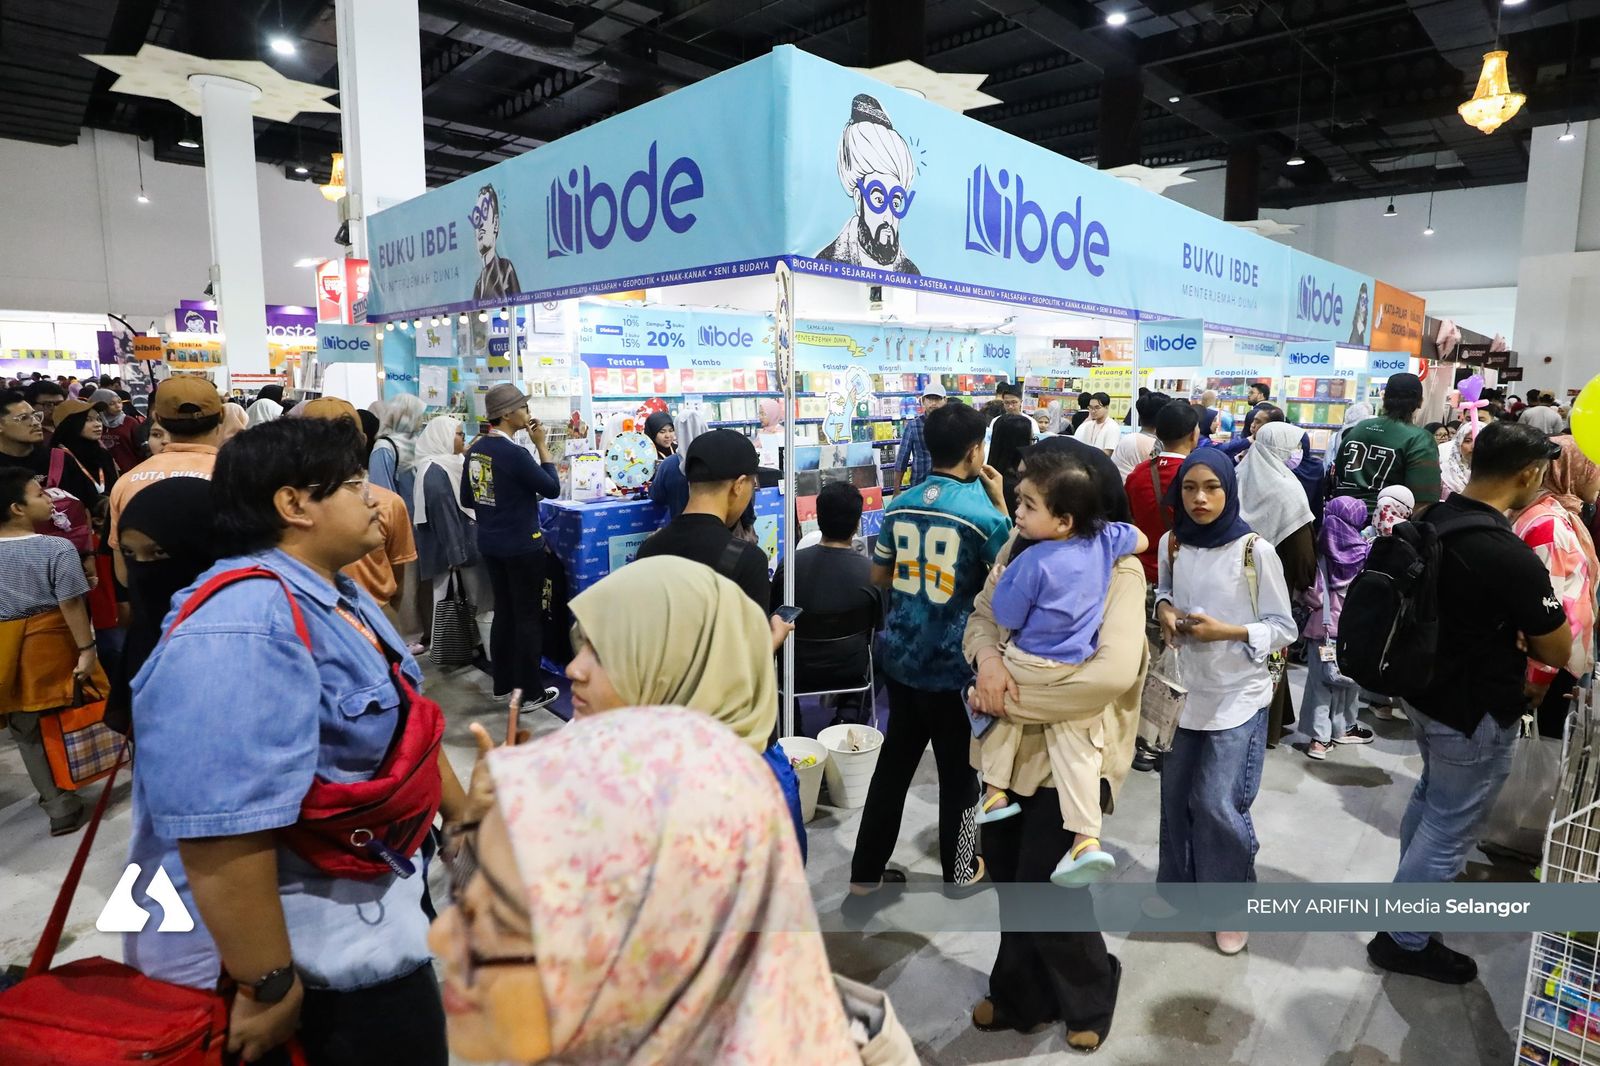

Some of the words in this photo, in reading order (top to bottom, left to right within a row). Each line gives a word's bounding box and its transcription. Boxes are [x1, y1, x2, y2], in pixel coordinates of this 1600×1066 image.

[378, 235, 415, 269] BUKU
[420, 221, 458, 258] IBDE
[1182, 242, 1224, 278] BUKU
[1229, 257, 1259, 288] IBDE
[592, 283, 618, 292] FALSAFAH
[622, 277, 655, 288] GEOPOLITIK
[661, 271, 707, 282] KANAK-KANAK
[714, 265, 730, 276] SENI
[731, 264, 737, 274] &
[739, 261, 770, 273] BUDAYA
[792, 257, 832, 273] BIOGRAFI
[841, 266, 877, 280] SEJARAH
[885, 273, 912, 285] AGAMA
[919, 279, 948, 290] SASTERA
[954, 284, 971, 294] ALAM
[972, 287, 995, 298] MELAYU
[1000, 291, 1027, 302] FALSAFAH
[1032, 296, 1061, 307] GEOPOLITIK
[622, 318, 640, 327] 10%
[665, 320, 672, 329] 3
[621, 337, 641, 348] 15%
[647, 331, 685, 348] 20%
[134, 344, 161, 352] biblio
[607, 357, 645, 367] Terlaris
[1094, 369, 1123, 377] Peluang
[1214, 368, 1259, 377] Geopolitik
[1339, 440, 1397, 491] 27
[130, 470, 165, 483] DUTA
[892, 521, 961, 605] 88
